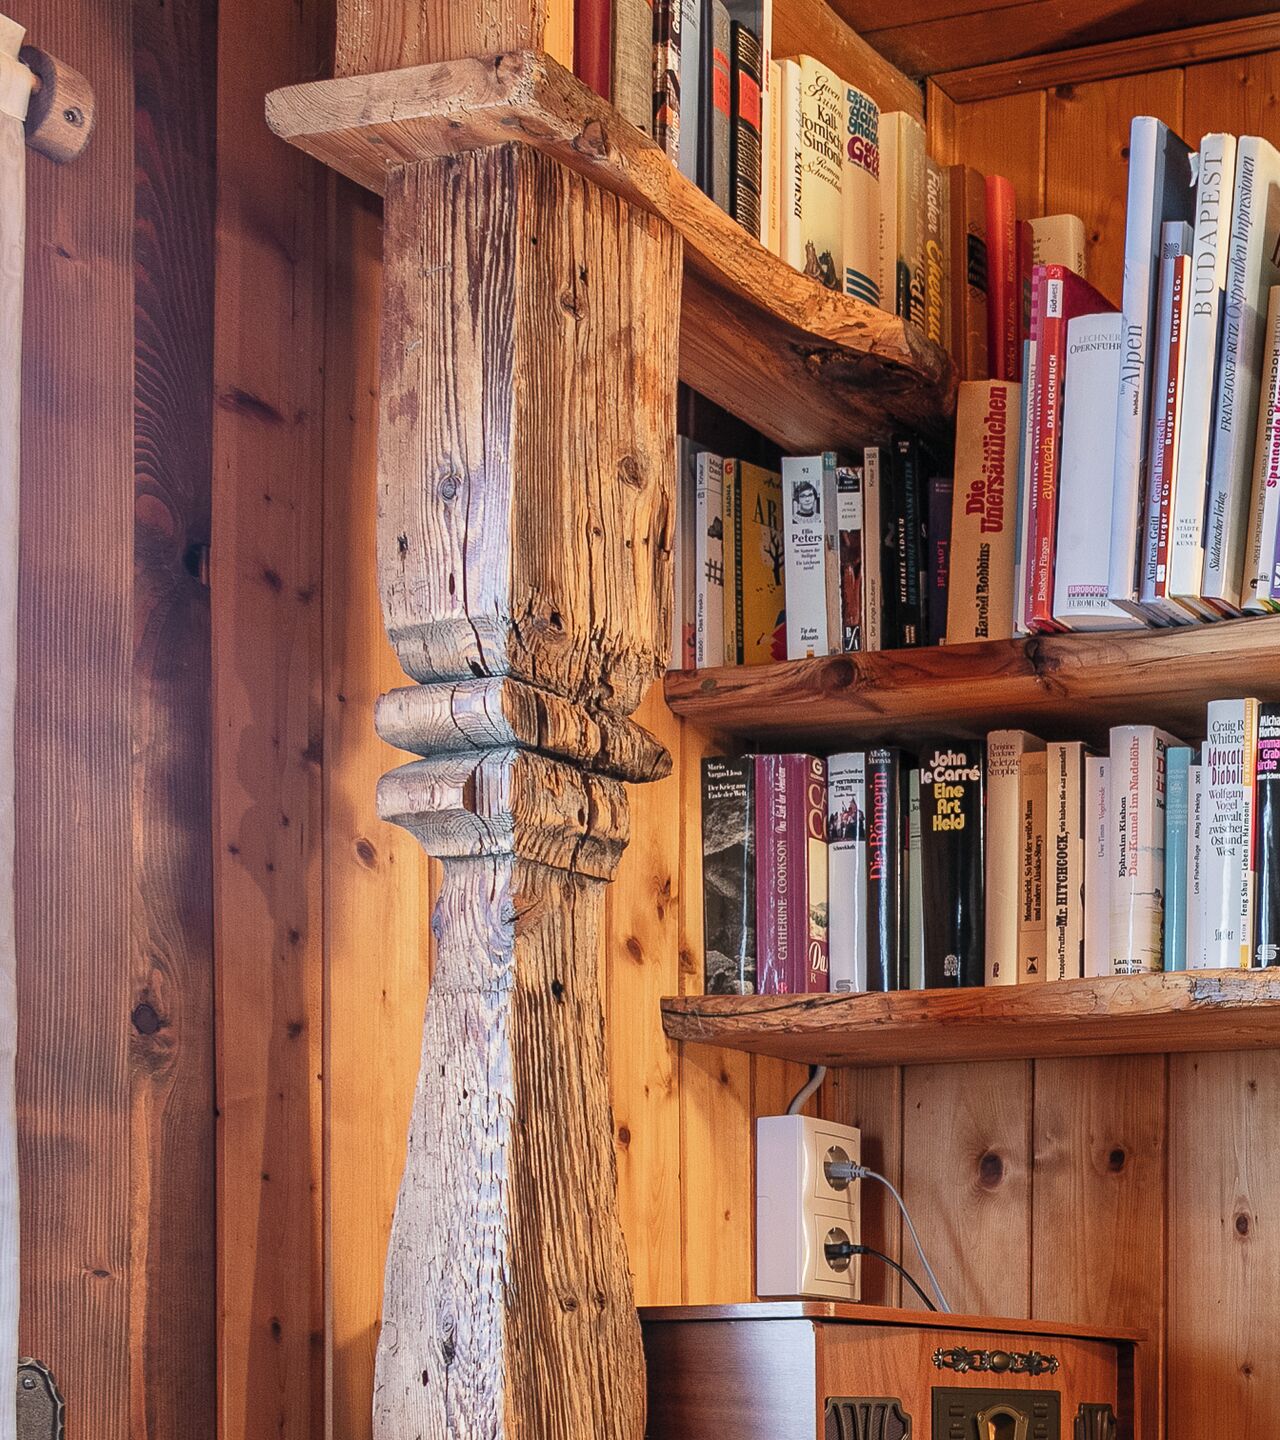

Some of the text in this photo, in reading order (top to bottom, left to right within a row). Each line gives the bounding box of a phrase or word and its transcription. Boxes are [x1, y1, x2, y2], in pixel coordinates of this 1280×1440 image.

[1193, 151, 1223, 317] BUDAPEST
[1170, 308, 1179, 343] Burger
[1122, 324, 1145, 388] Alpen
[965, 386, 1008, 534] Die Unersättlichen
[1042, 436, 1055, 500] ayurveda
[929, 749, 967, 768] John
[920, 765, 982, 785] le Carré
[933, 783, 965, 799] Eine
[937, 799, 961, 815] Art
[933, 814, 965, 832] Held
